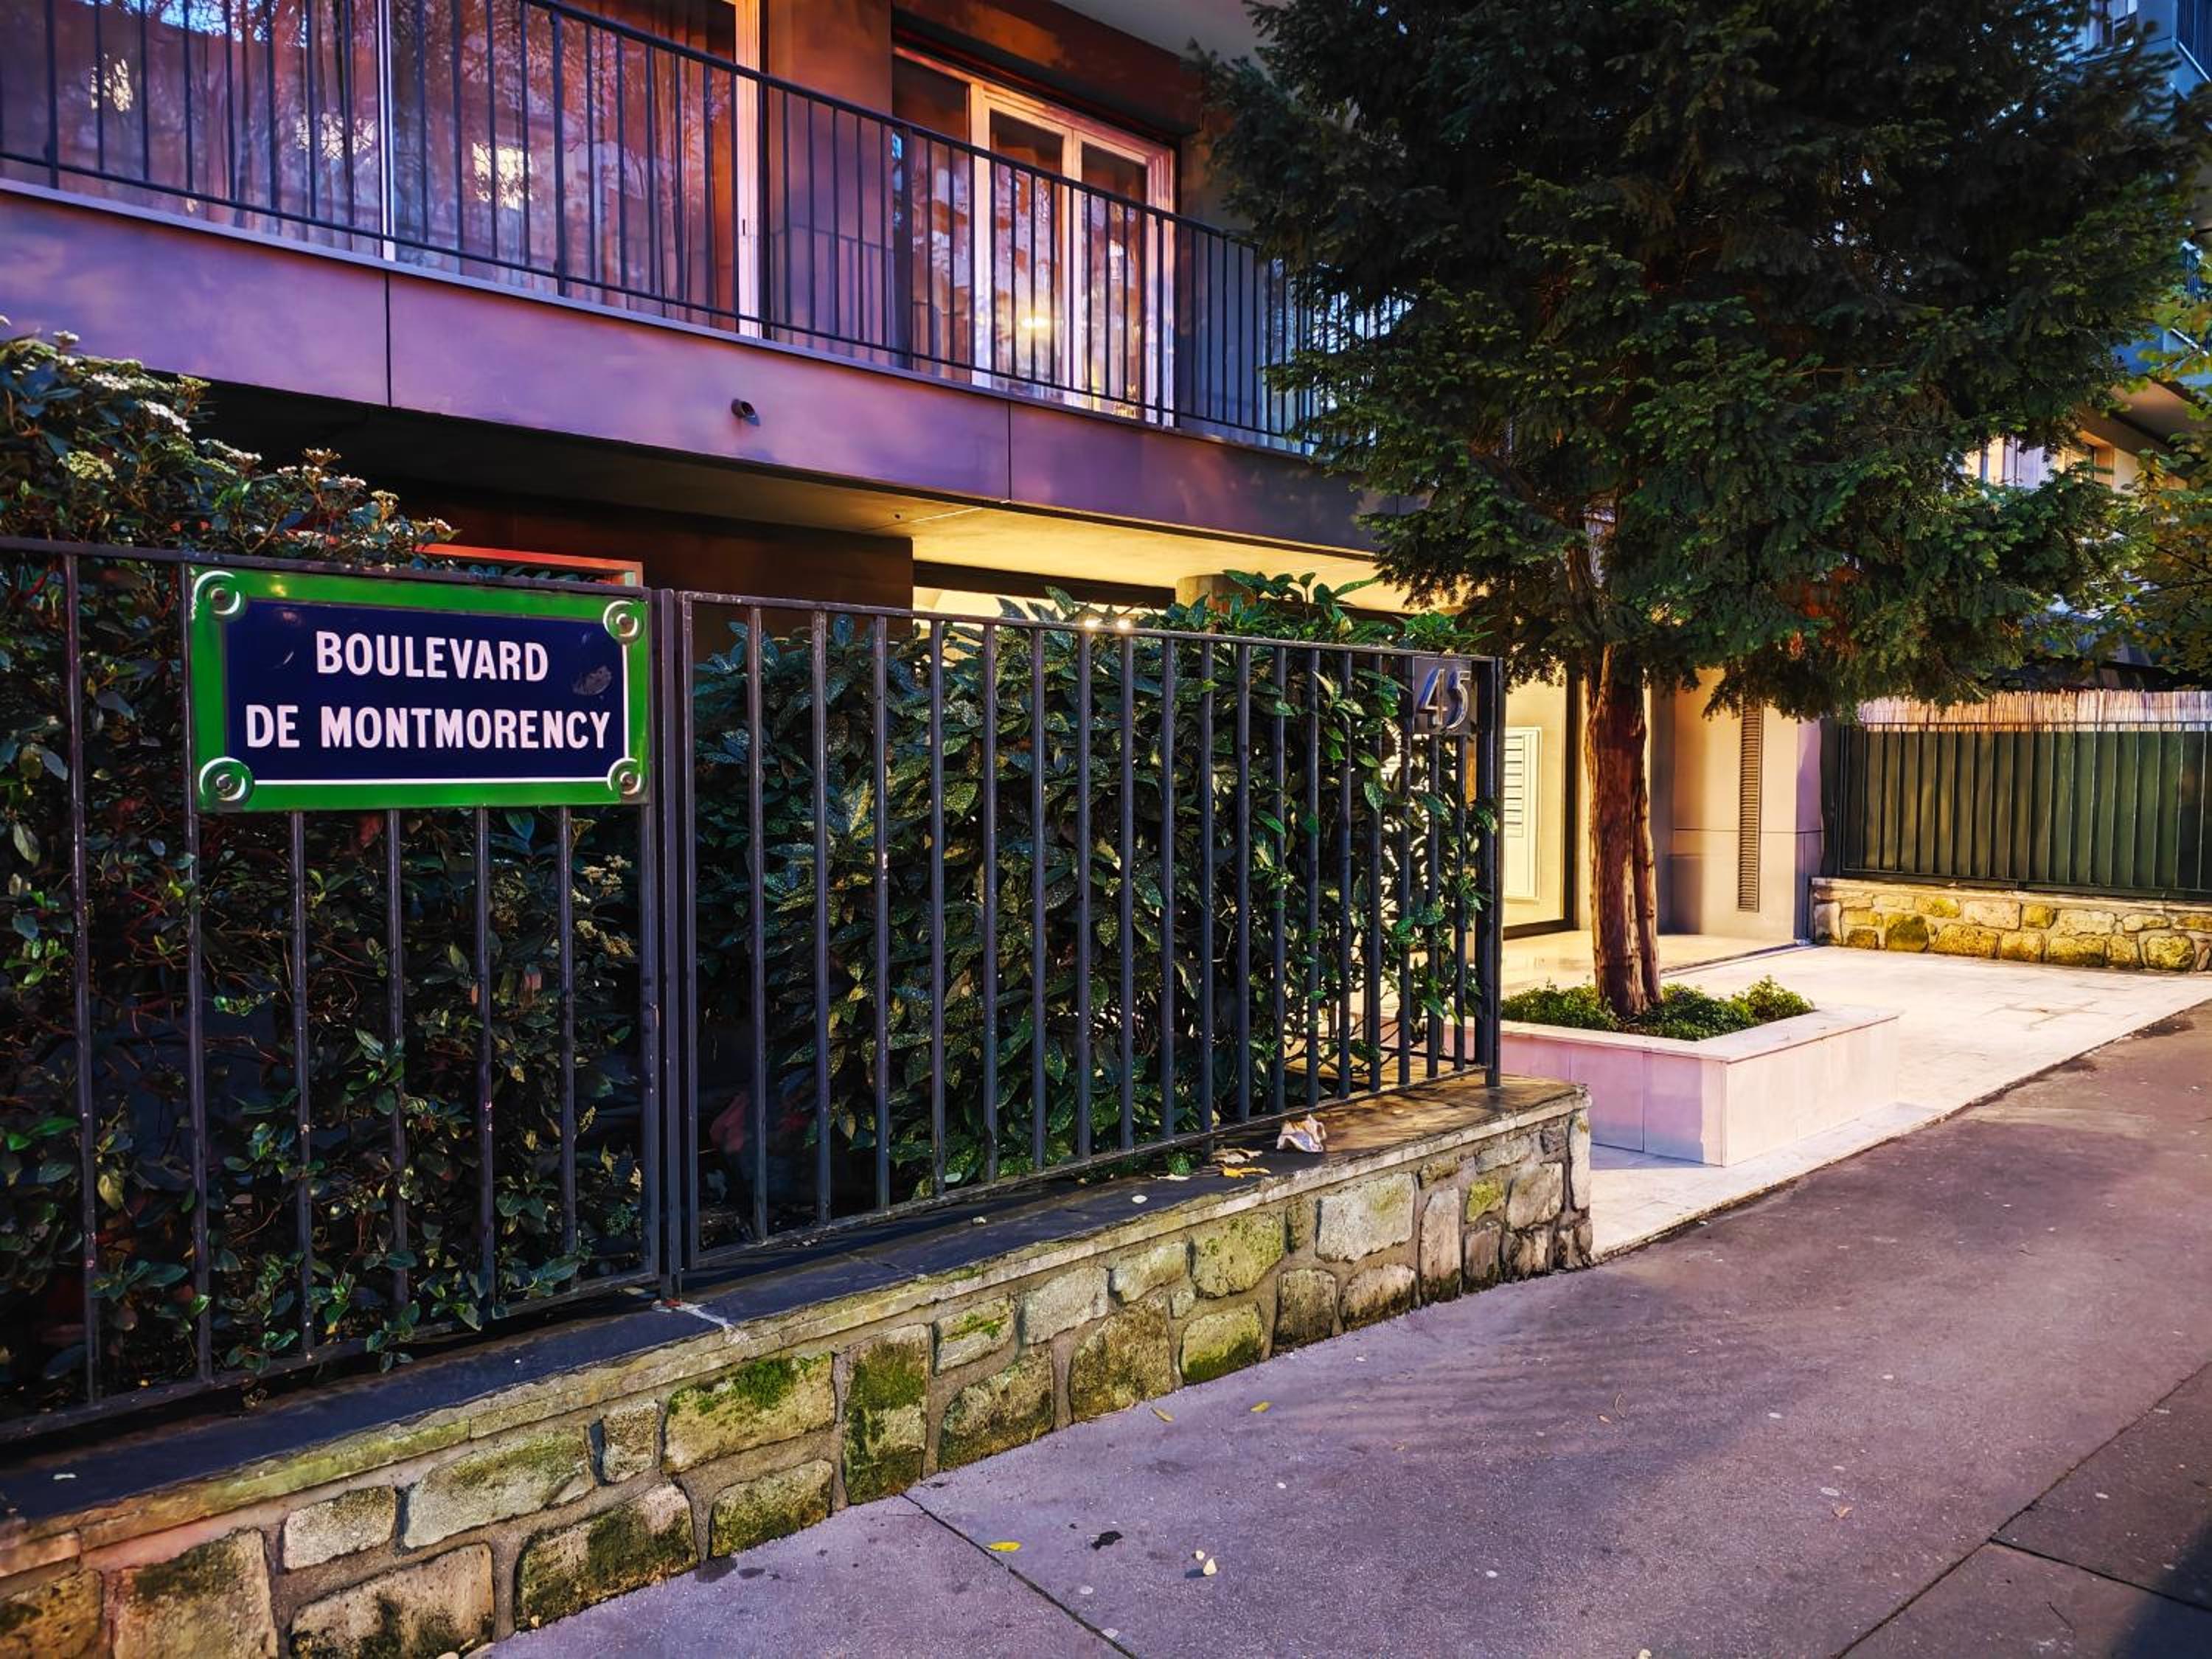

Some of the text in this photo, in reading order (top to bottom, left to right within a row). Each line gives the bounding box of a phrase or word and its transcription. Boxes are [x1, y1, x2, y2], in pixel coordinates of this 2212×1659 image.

[316, 630, 549, 682] BOULEVARD
[1417, 666, 1472, 730] 45
[246, 704, 611, 749] DE MONTMORENCY
